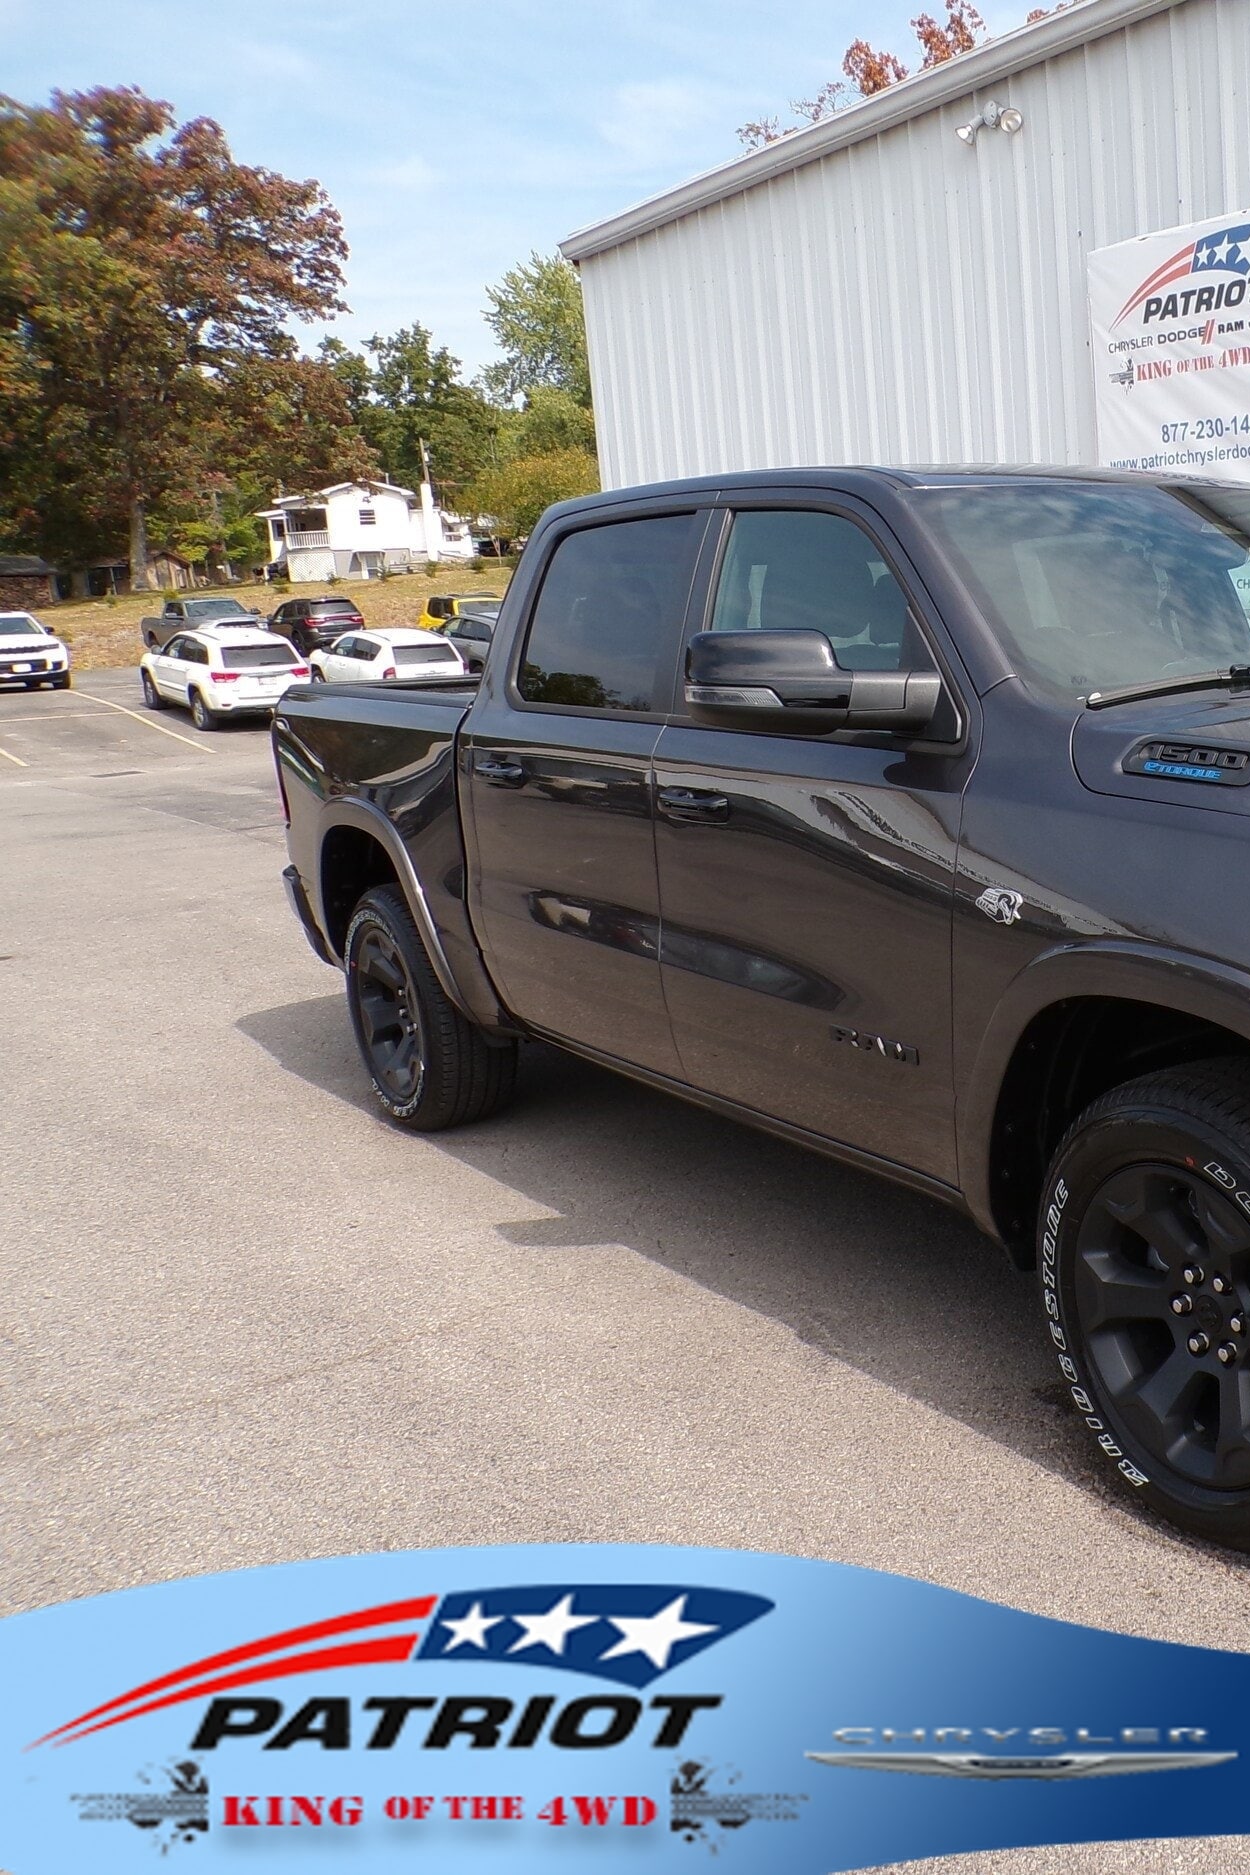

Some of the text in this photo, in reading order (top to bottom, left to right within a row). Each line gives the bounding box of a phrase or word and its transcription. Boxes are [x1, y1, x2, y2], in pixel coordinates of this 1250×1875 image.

[1108, 336, 1153, 353] CHRYSLER
[1157, 327, 1205, 344] DODGE
[1217, 322, 1244, 334] RAM
[1137, 360, 1172, 381] KING
[1176, 359, 1191, 373] OF
[1193, 356, 1214, 370] THE
[1146, 744, 1250, 770] 1500
[1042, 1178, 1150, 1487] BRIDGESTONE
